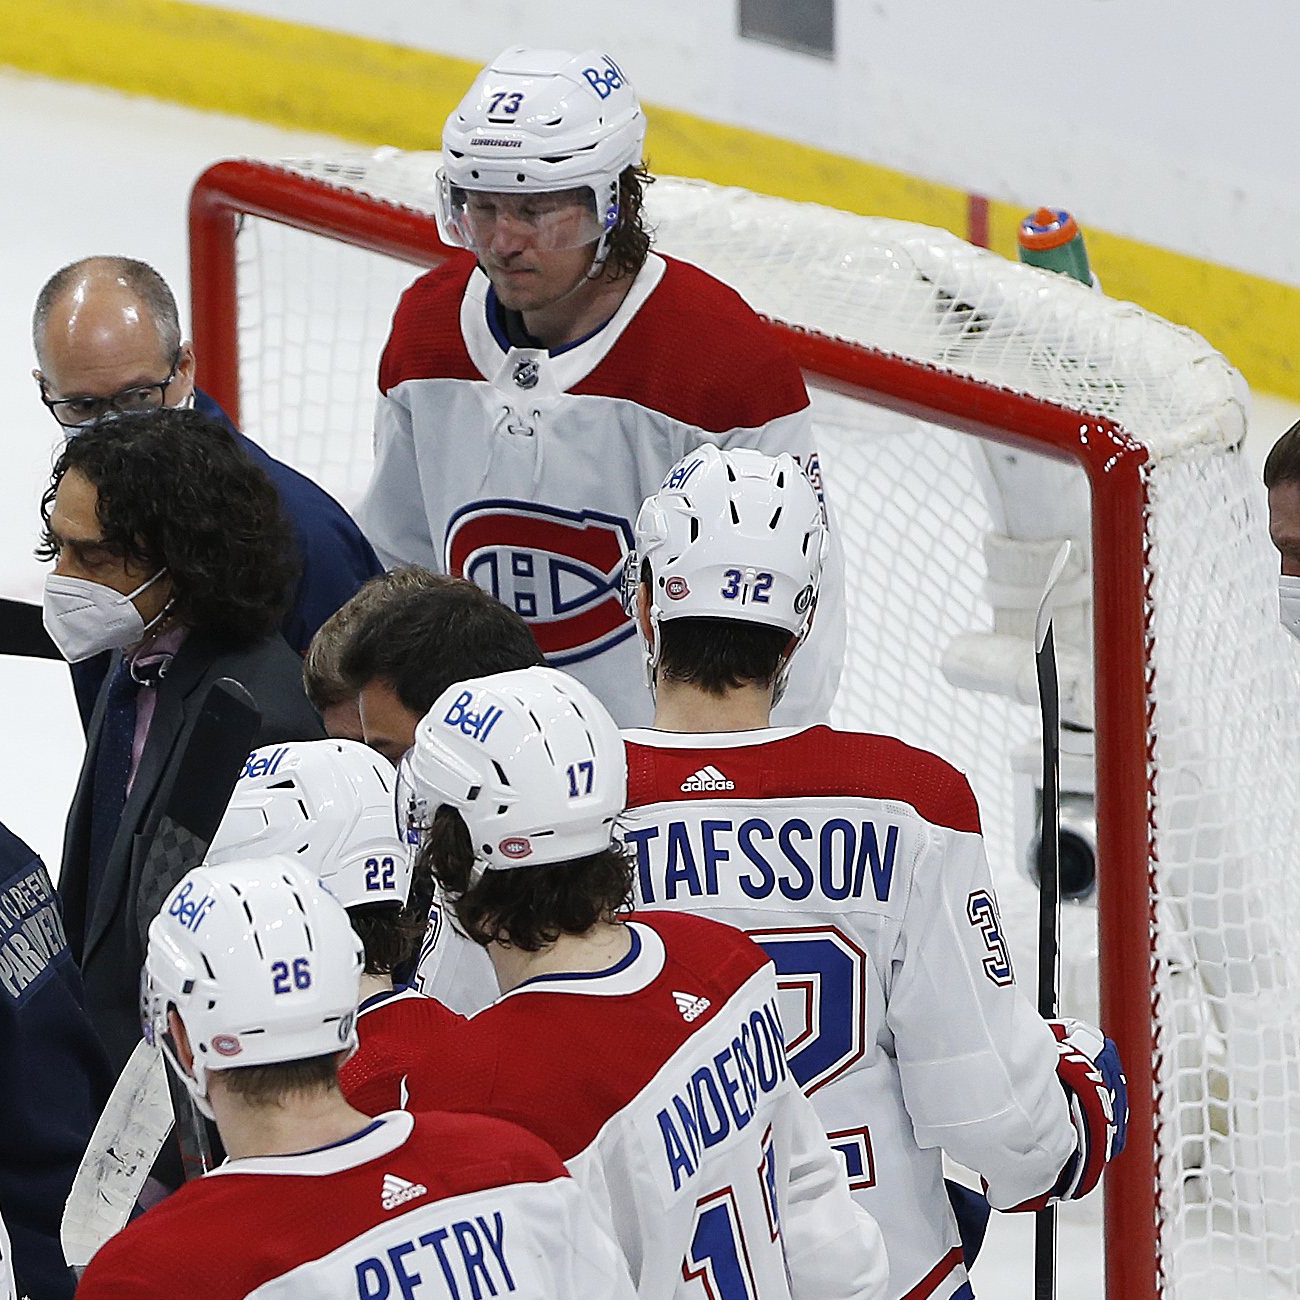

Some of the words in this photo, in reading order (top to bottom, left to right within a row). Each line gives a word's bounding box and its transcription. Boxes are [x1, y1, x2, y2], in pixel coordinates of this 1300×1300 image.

[582, 54, 629, 100] Bell
[487, 93, 524, 115] 73
[470, 138, 522, 148] WARRIOR
[662, 459, 704, 490] ell
[721, 570, 774, 605] 32
[444, 690, 503, 743] Bell
[238, 748, 289, 780] Bell
[566, 760, 594, 798] 17
[680, 777, 735, 793] adidas
[364, 857, 396, 892] 22
[625, 818, 900, 905] TAFSSON
[169, 881, 215, 933] Bell
[966, 888, 1016, 988] 3
[271, 957, 311, 996] 26
